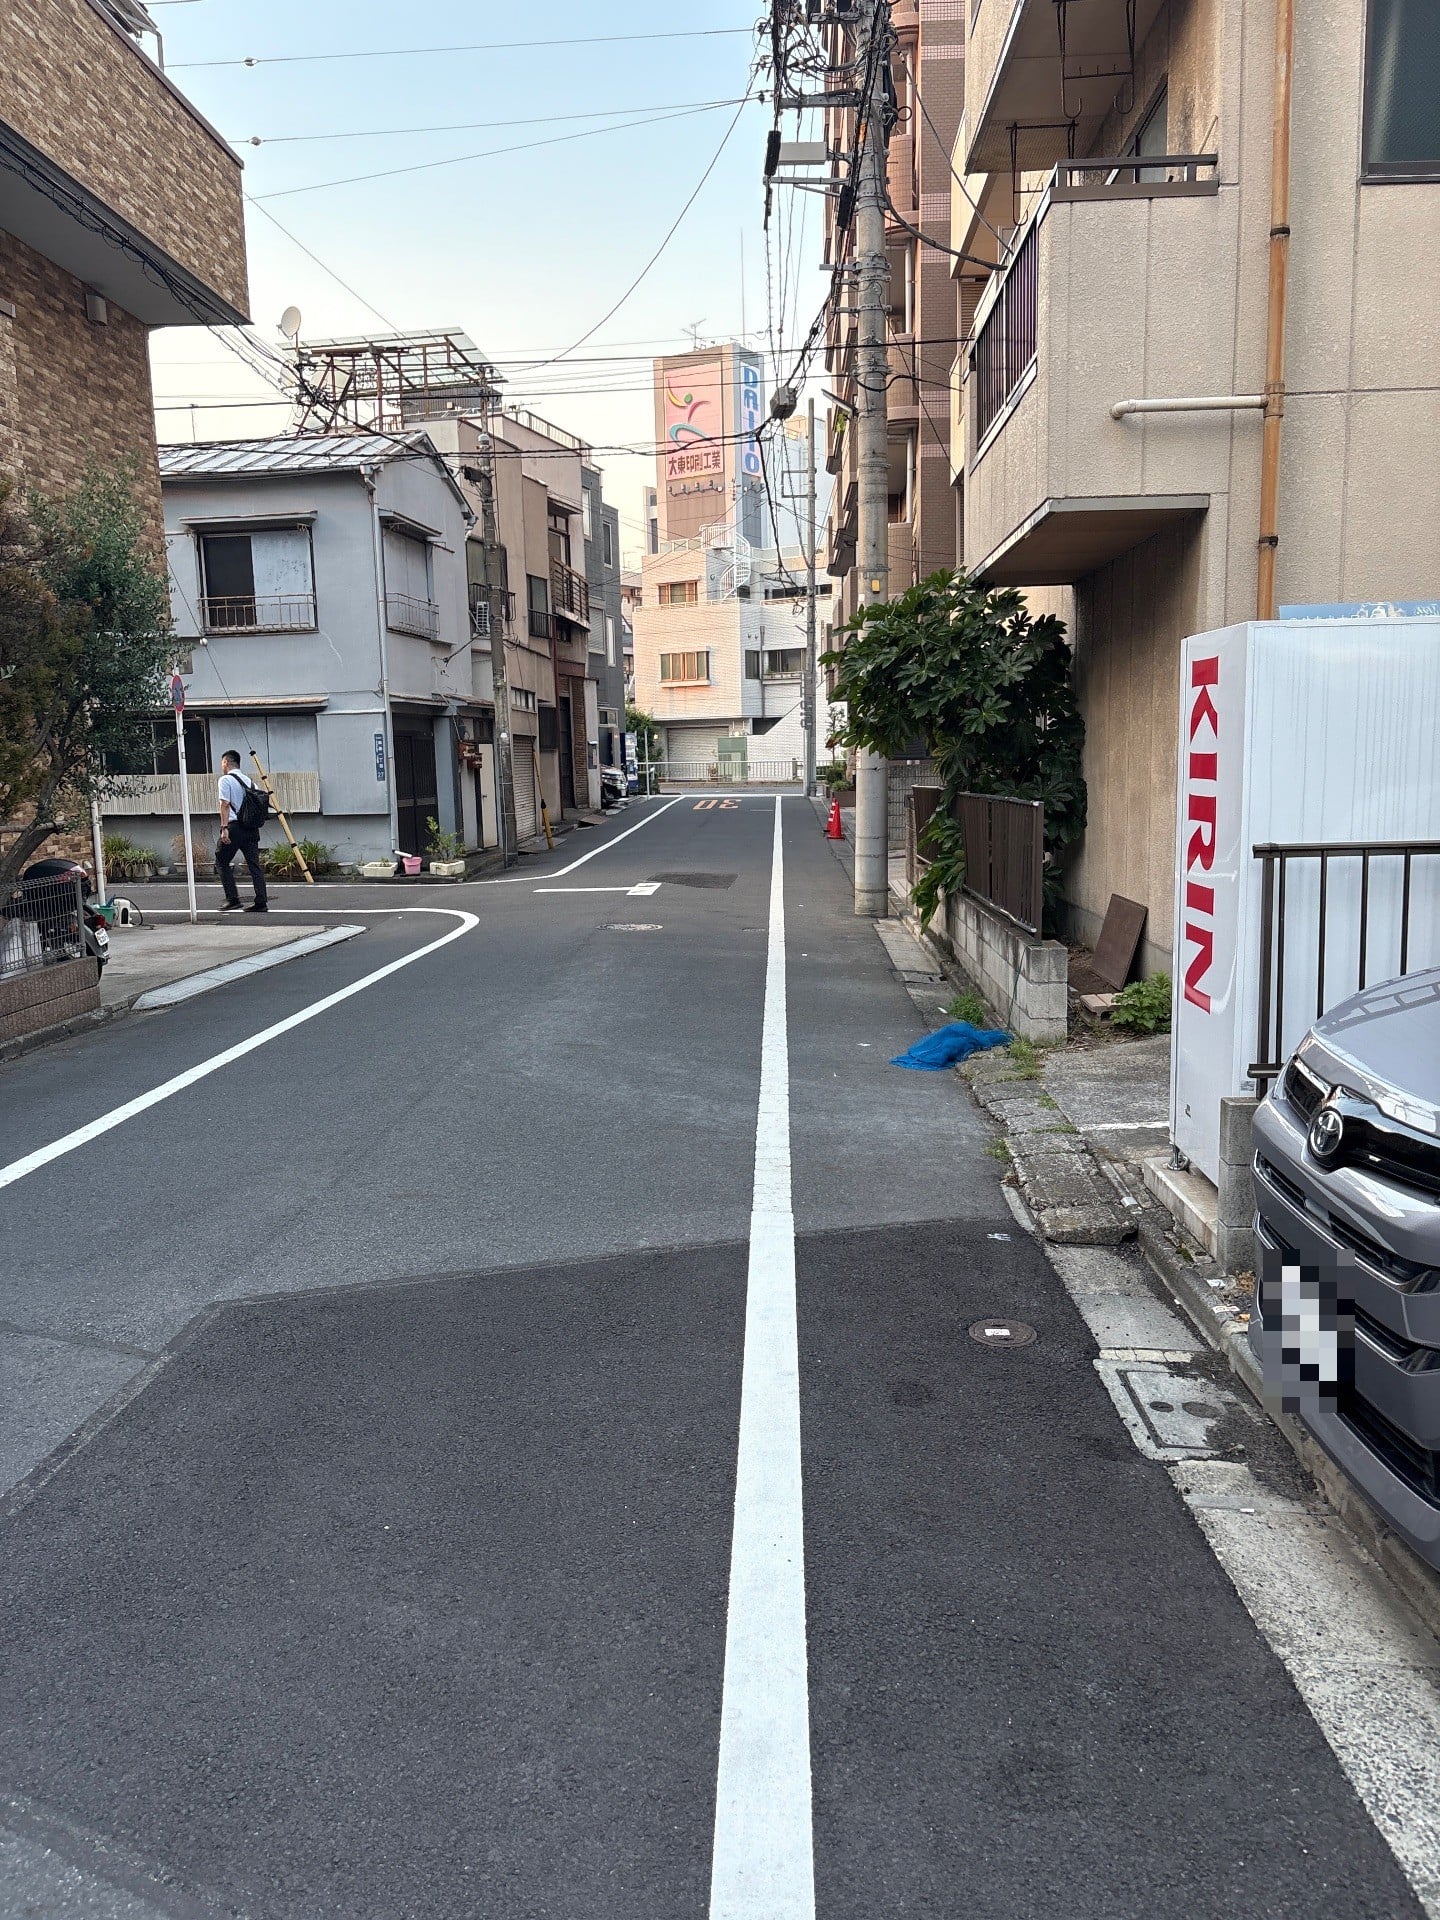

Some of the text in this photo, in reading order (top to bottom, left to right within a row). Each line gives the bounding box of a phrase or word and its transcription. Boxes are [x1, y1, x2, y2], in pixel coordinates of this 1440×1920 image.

[668, 449, 721, 476] 大東印刷工業
[1184, 655, 1219, 1015] KIRIN
